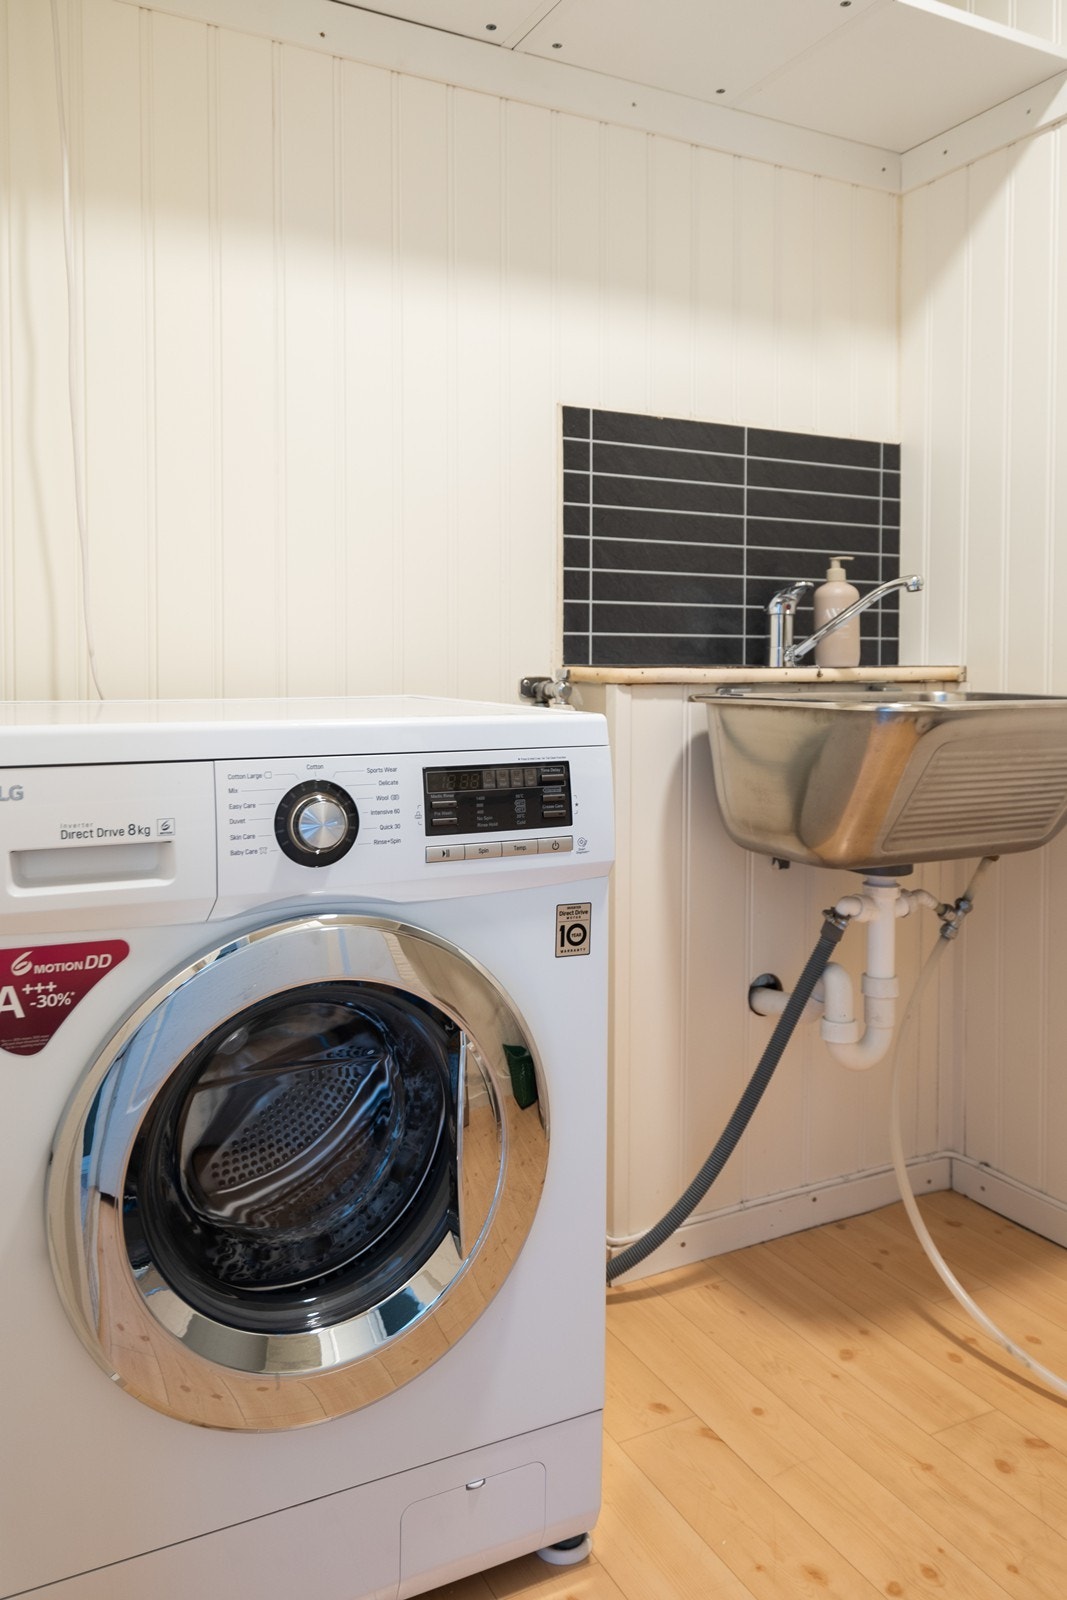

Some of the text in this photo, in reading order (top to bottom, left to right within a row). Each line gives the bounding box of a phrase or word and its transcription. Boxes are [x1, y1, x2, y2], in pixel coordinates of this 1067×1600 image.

[0, 784, 24, 801] LG
[60, 829, 94, 840] Direct
[97, 826, 125, 838] Drive
[560, 923, 587, 948] 10
[34, 960, 84, 974] MOTION
